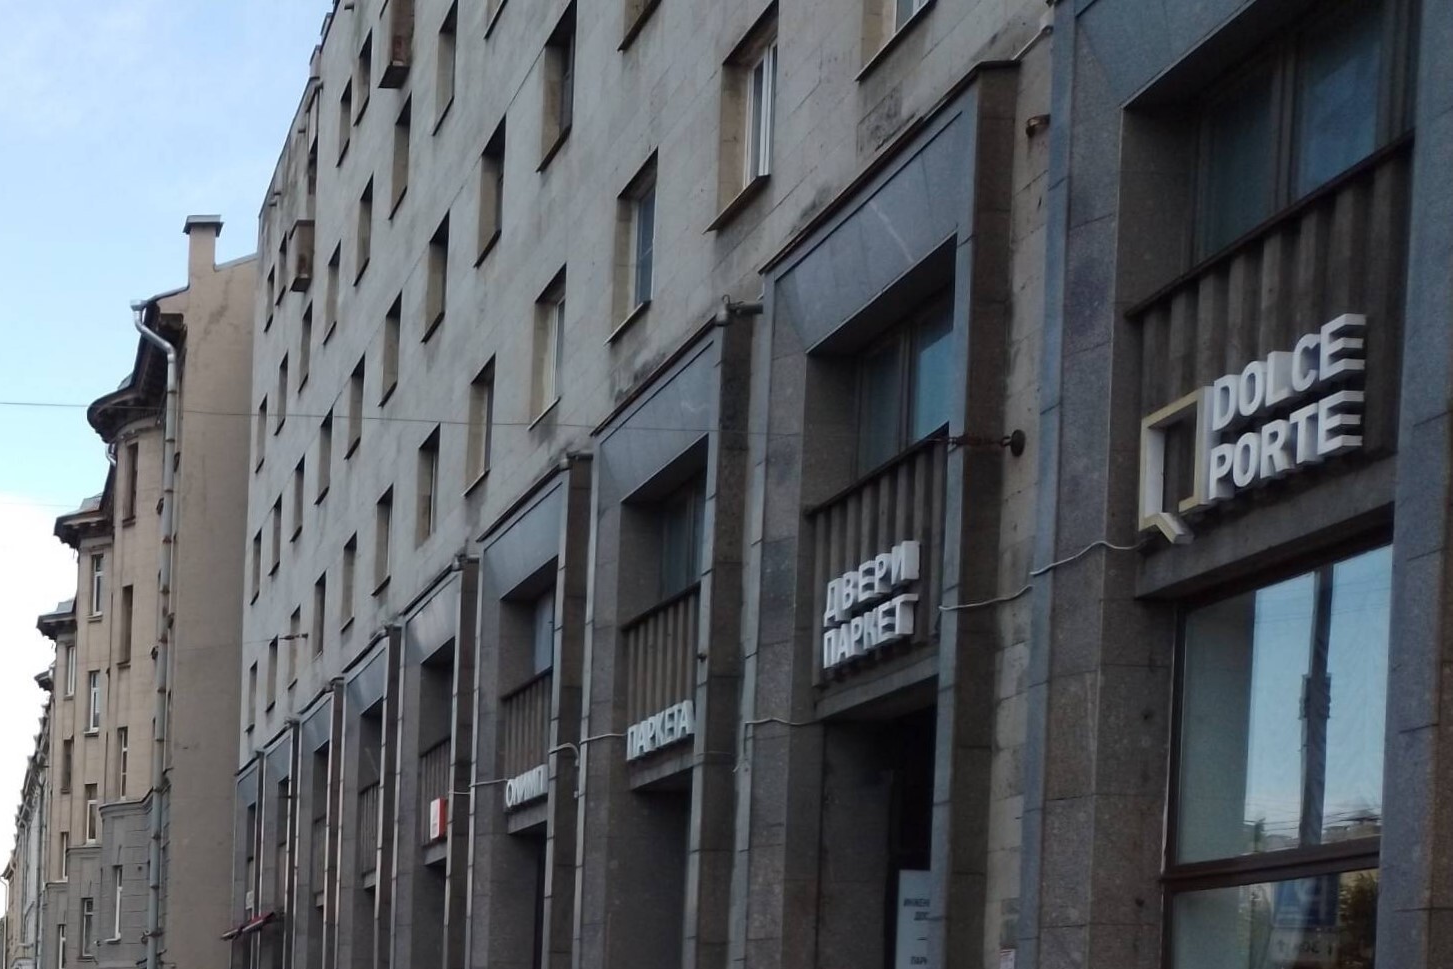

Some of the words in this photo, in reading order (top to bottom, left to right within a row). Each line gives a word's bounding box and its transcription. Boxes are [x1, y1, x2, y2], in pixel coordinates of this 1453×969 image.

[1212, 313, 1366, 431] DOLCE
[1209, 390, 1364, 500] PORTE
[824, 540, 920, 627] ДВЕРИ
[824, 594, 919, 669] ПАРКЕТ
[626, 700, 694, 761] ПАРКЕТА
